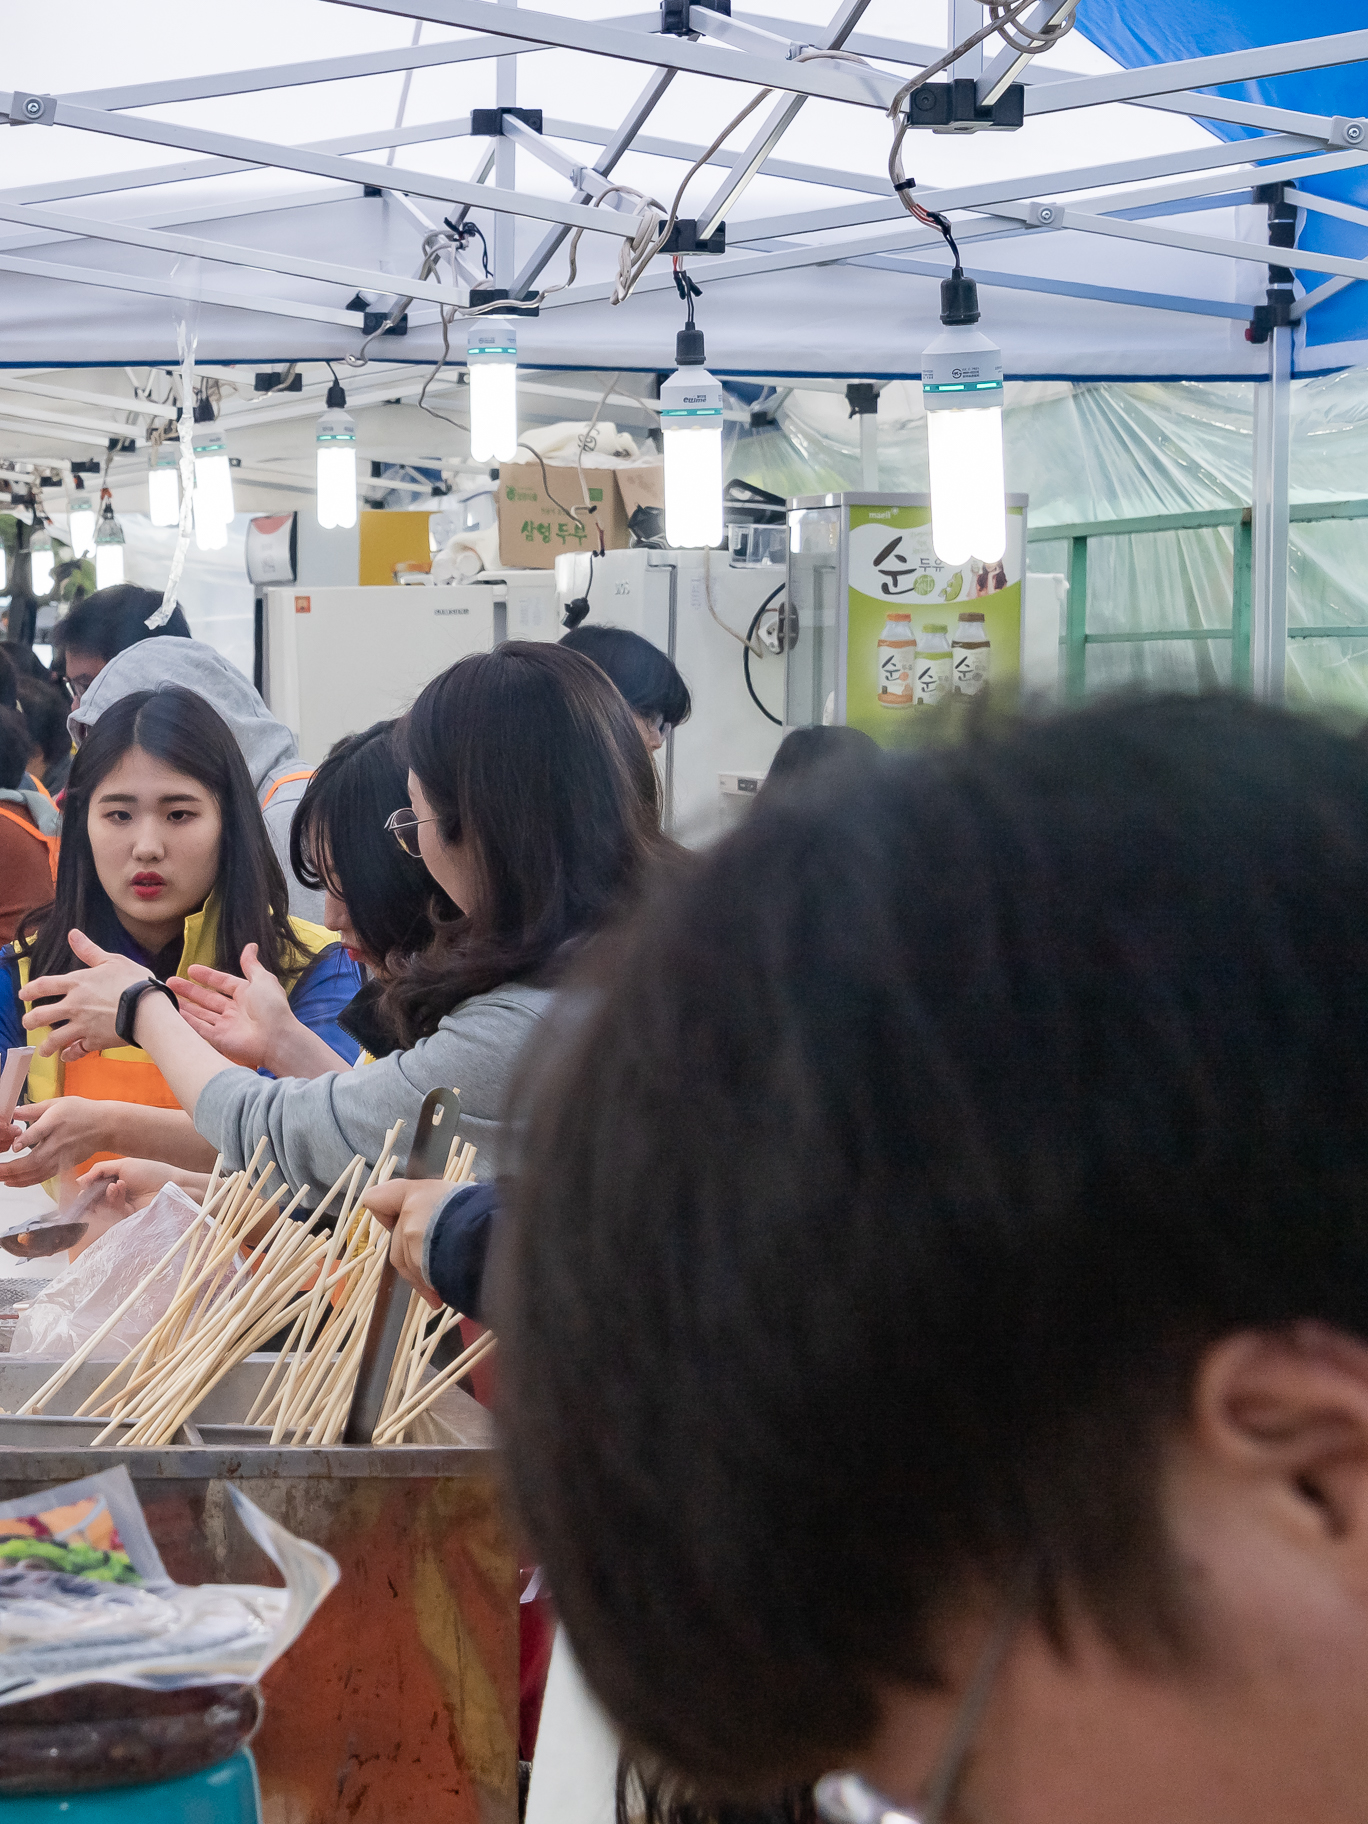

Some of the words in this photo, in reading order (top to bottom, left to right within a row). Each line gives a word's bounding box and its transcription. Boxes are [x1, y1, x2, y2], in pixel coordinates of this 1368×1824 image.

[521, 520, 551, 544] 삼영
[873, 535, 917, 596] 순
[881, 654, 901, 682] 순
[917, 666, 938, 693] 순
